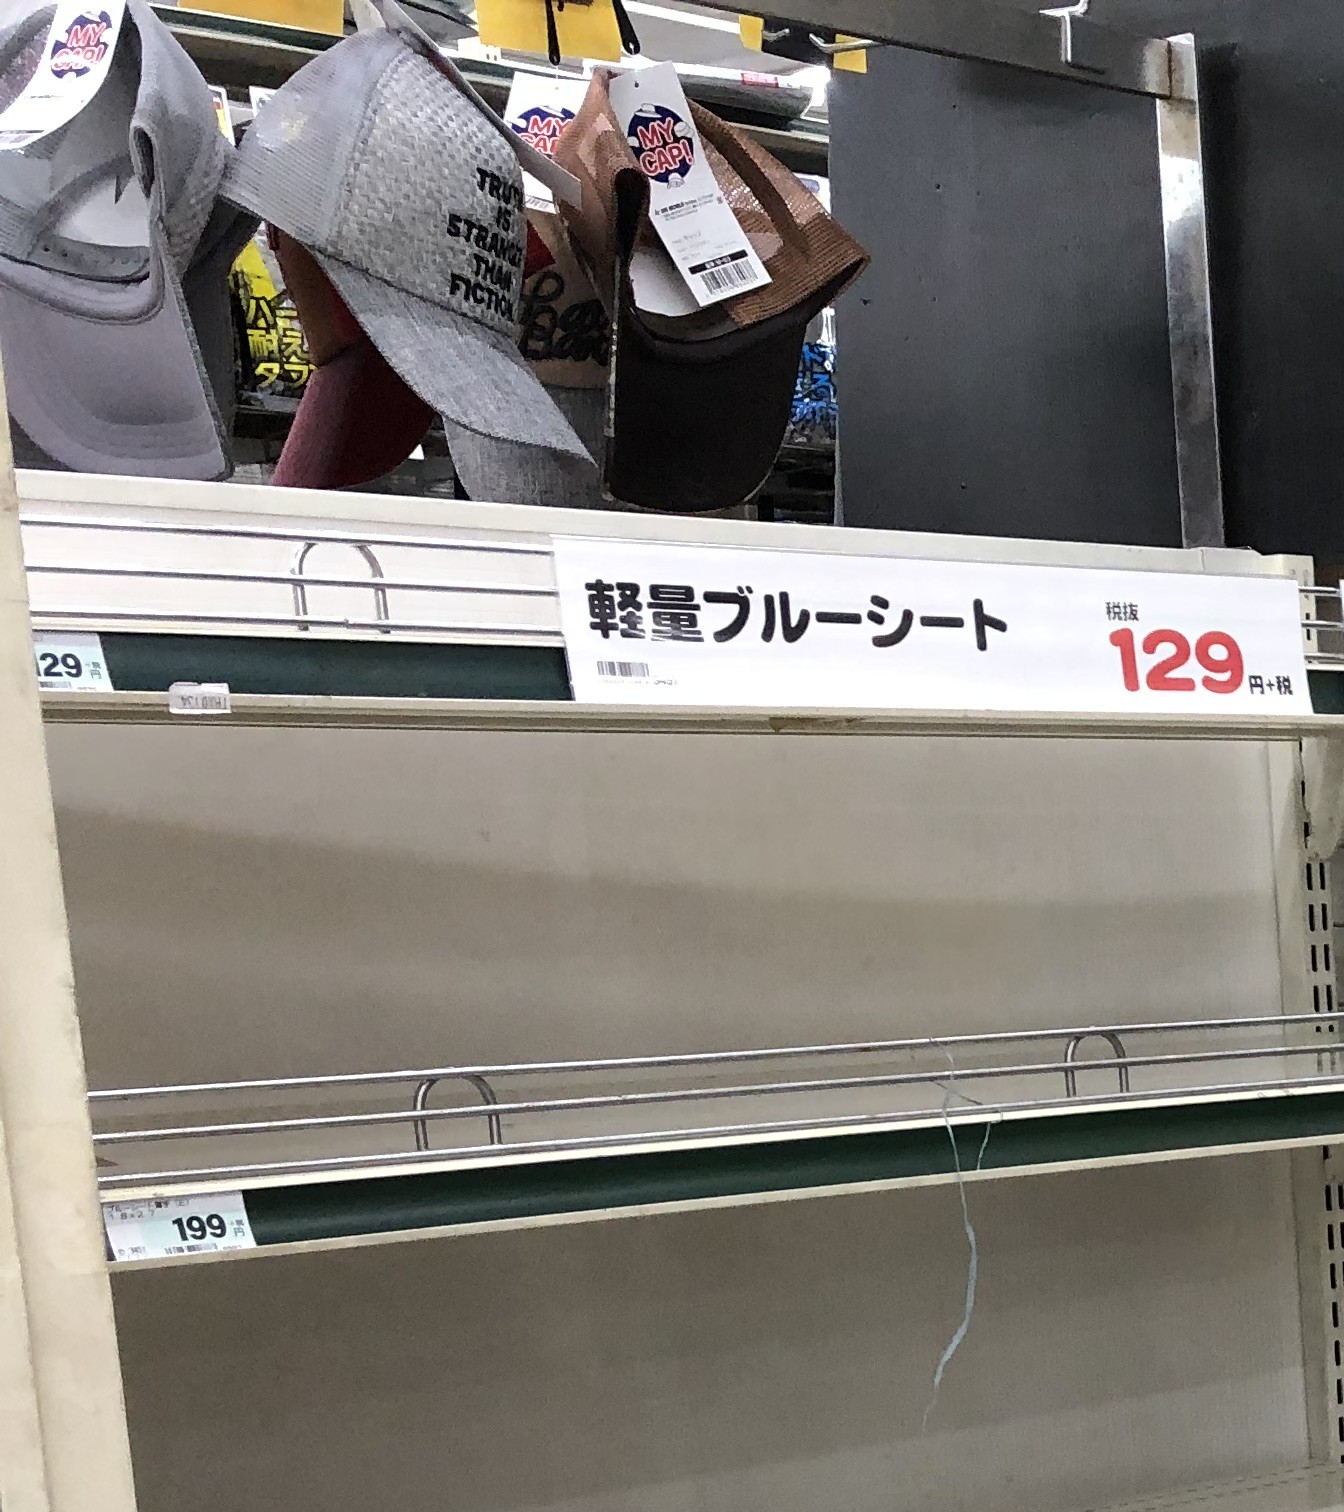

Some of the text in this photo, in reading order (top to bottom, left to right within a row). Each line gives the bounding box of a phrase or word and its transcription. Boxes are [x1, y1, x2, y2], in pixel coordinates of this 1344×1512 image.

[636, 117, 675, 149] MY
[639, 140, 695, 176] CAP!
[585, 578, 1008, 652] 軽量ブルーシート
[1105, 600, 1139, 623] 税抜
[37, 651, 84, 679] 29
[1109, 627, 1294, 697] 129 円+税
[171, 1213, 227, 1242] 199
